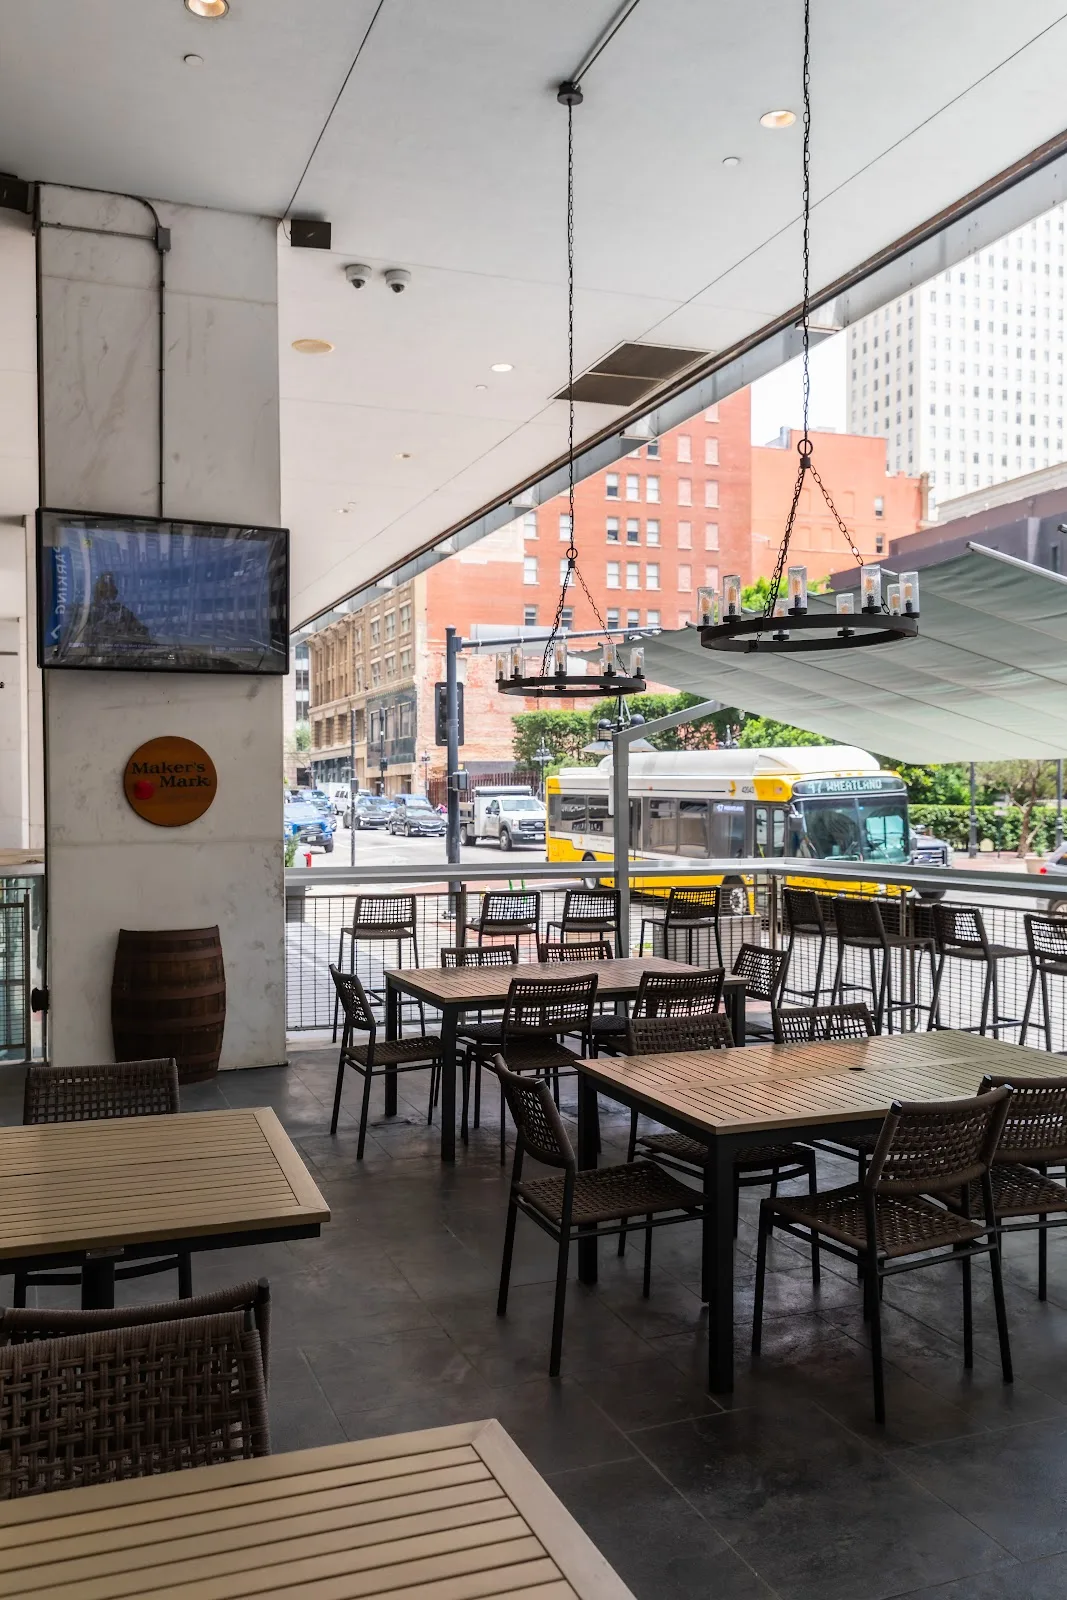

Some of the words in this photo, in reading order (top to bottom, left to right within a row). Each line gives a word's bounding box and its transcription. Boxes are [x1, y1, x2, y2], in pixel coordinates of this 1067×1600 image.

[131, 761, 206, 775] Maker's
[159, 775, 211, 788] Mark
[807, 780, 823, 794] 47
[826, 778, 883, 792] WHEATLAND
